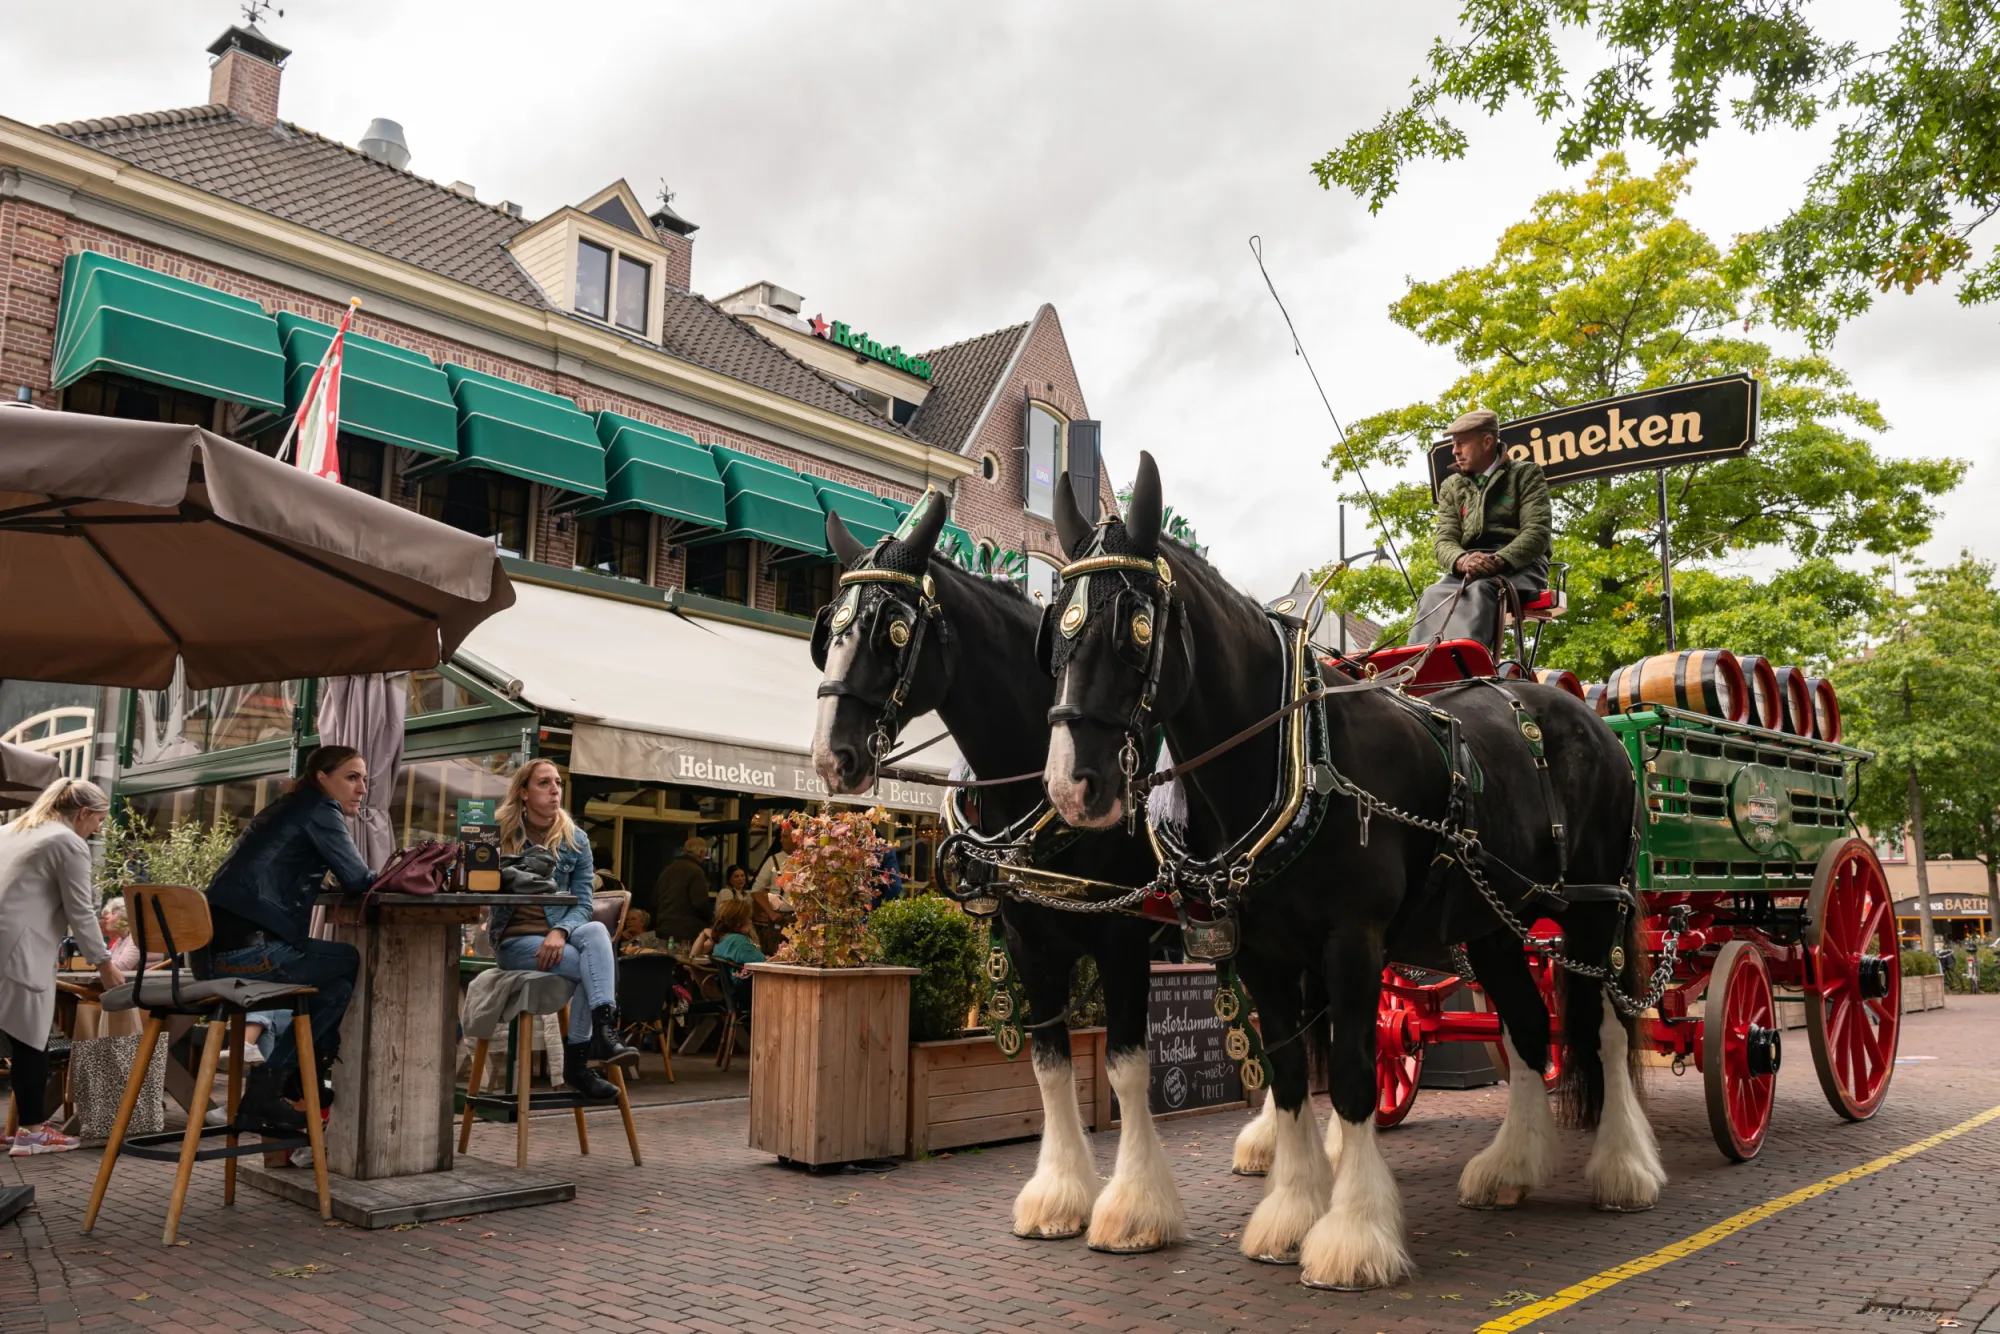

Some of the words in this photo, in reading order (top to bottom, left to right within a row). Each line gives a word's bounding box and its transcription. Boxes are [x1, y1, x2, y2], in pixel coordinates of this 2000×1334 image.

[832, 320, 931, 379] Heineken
[1507, 408, 1703, 467] eineken
[679, 755, 775, 787] Heineken
[890, 781, 933, 805] Beurs
[1944, 898, 1989, 910] BARTH
[1174, 990, 1180, 1001] IN
[1181, 989, 1201, 1001] MEPPEL
[1207, 1036, 1219, 1046] VAN
[1160, 1036, 1198, 1065] biefstuk
[1203, 1049, 1224, 1062] MEPPEL
[1202, 1083, 1224, 1099] FRIET
